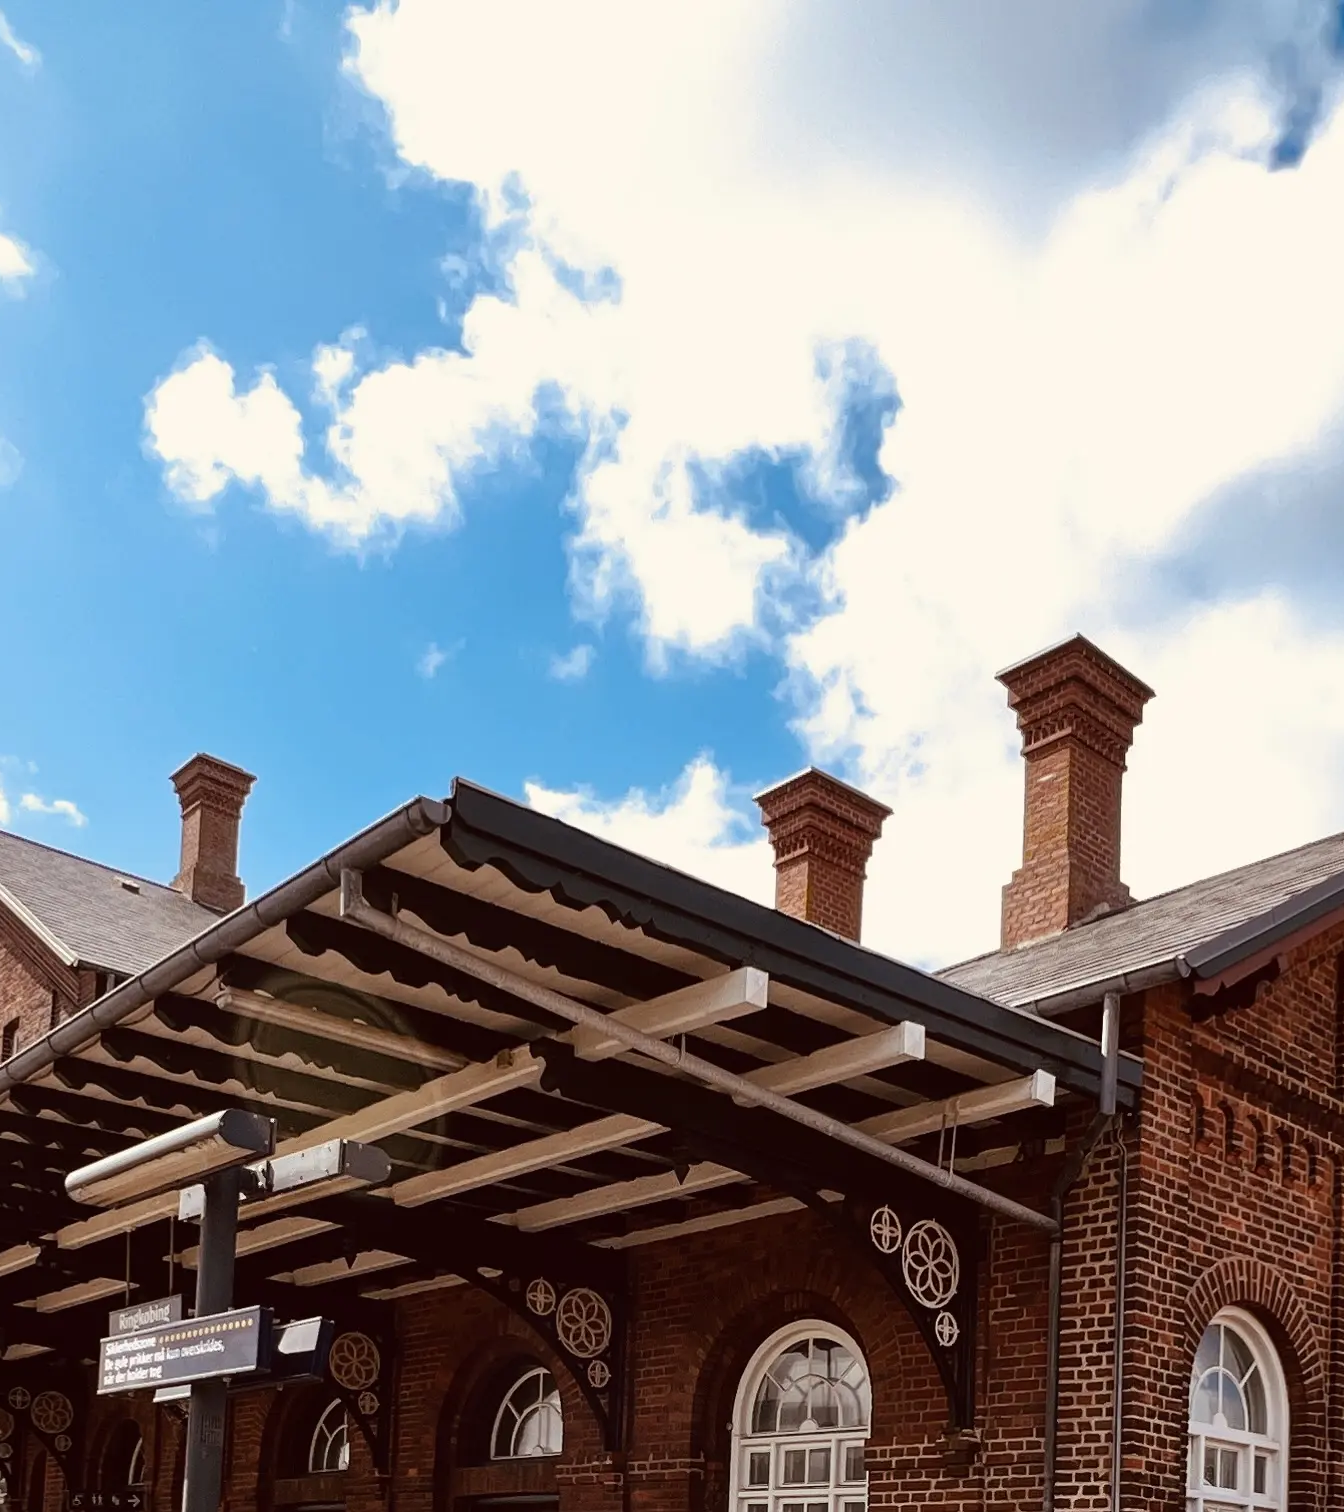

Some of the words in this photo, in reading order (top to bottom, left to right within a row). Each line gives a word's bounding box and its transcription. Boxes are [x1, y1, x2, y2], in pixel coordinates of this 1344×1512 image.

[104, 1358, 114, 1371] De
[114, 1355, 128, 1371] gule
[129, 1351, 154, 1370] prikker
[166, 1347, 180, 1360] kun
[115, 1371, 127, 1384] der
[127, 1367, 149, 1381] holder
[149, 1365, 163, 1379] tog
